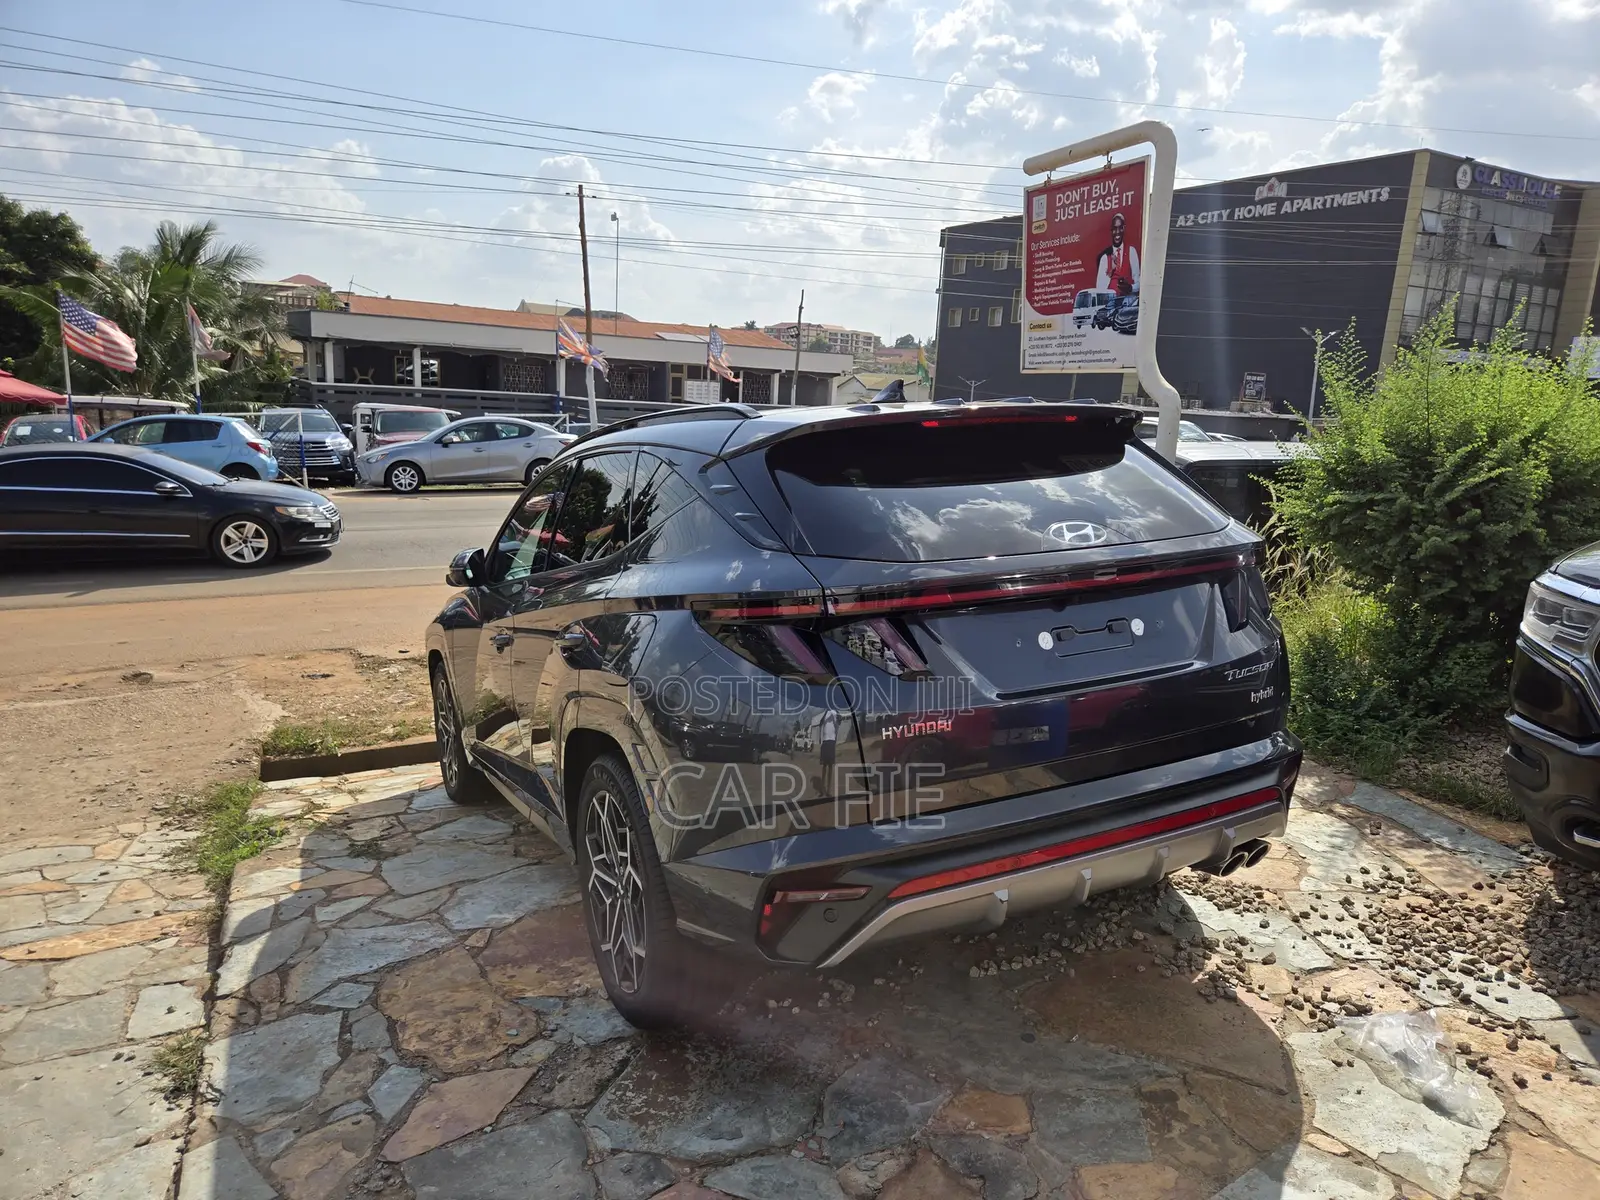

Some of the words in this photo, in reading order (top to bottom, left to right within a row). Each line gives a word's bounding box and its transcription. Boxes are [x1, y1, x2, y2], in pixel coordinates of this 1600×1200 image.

[1056, 186, 1090, 207] DON'T
[1092, 179, 1119, 198] BUY,
[1054, 202, 1081, 222] JUST
[1083, 194, 1119, 216] LEASE
[1122, 191, 1134, 207] IT
[1176, 213, 1195, 228] A2
[1198, 208, 1231, 224] CITY
[1234, 202, 1277, 220] HOME
[1280, 186, 1391, 214] APARTMENTS
[1039, 238, 1060, 250] Services
[1251, 686, 1274, 703] hybrid
[882, 719, 952, 741] HYUNDAI
